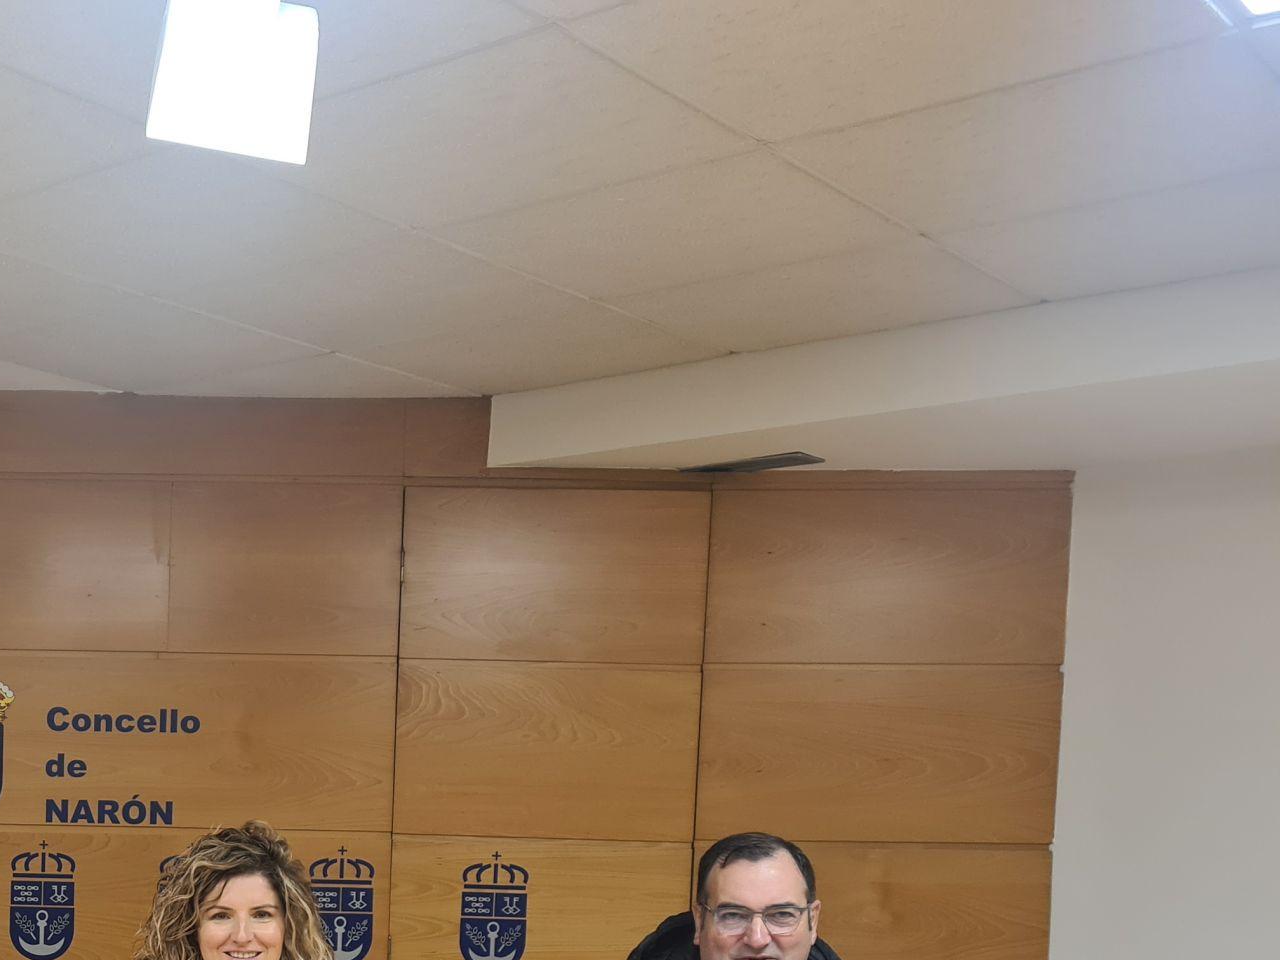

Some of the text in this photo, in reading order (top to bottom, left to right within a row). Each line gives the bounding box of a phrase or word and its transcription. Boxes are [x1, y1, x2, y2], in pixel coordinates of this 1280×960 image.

[46, 706, 202, 735] Concello
[44, 752, 88, 778] de
[44, 794, 174, 826] NARÓN
